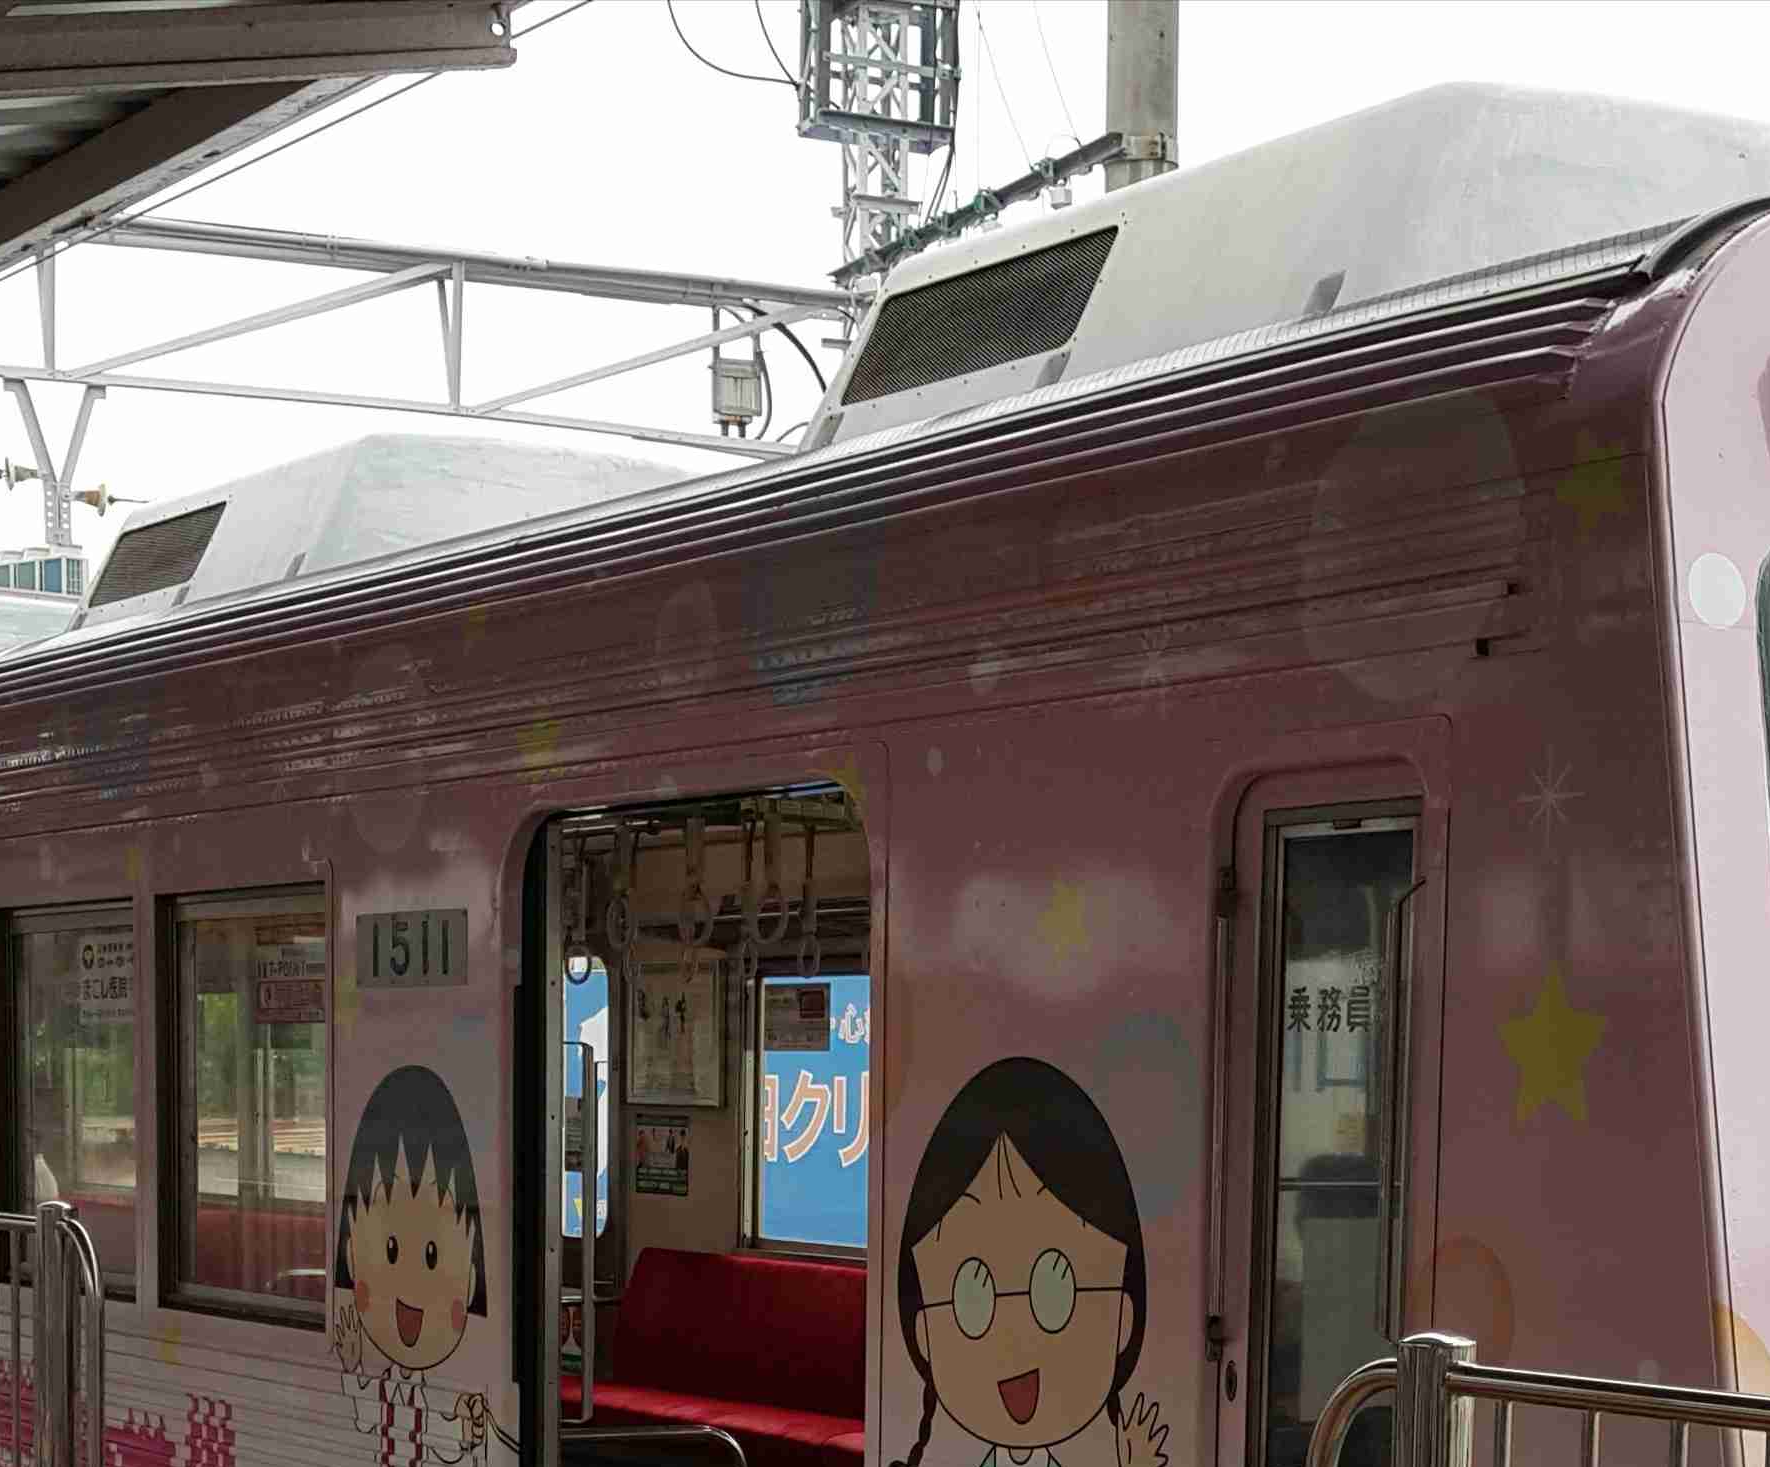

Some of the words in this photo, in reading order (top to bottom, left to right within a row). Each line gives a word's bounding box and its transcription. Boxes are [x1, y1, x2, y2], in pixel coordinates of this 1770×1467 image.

[372, 919, 449, 976] 1511
[1286, 985, 1375, 1032] 乗務員
